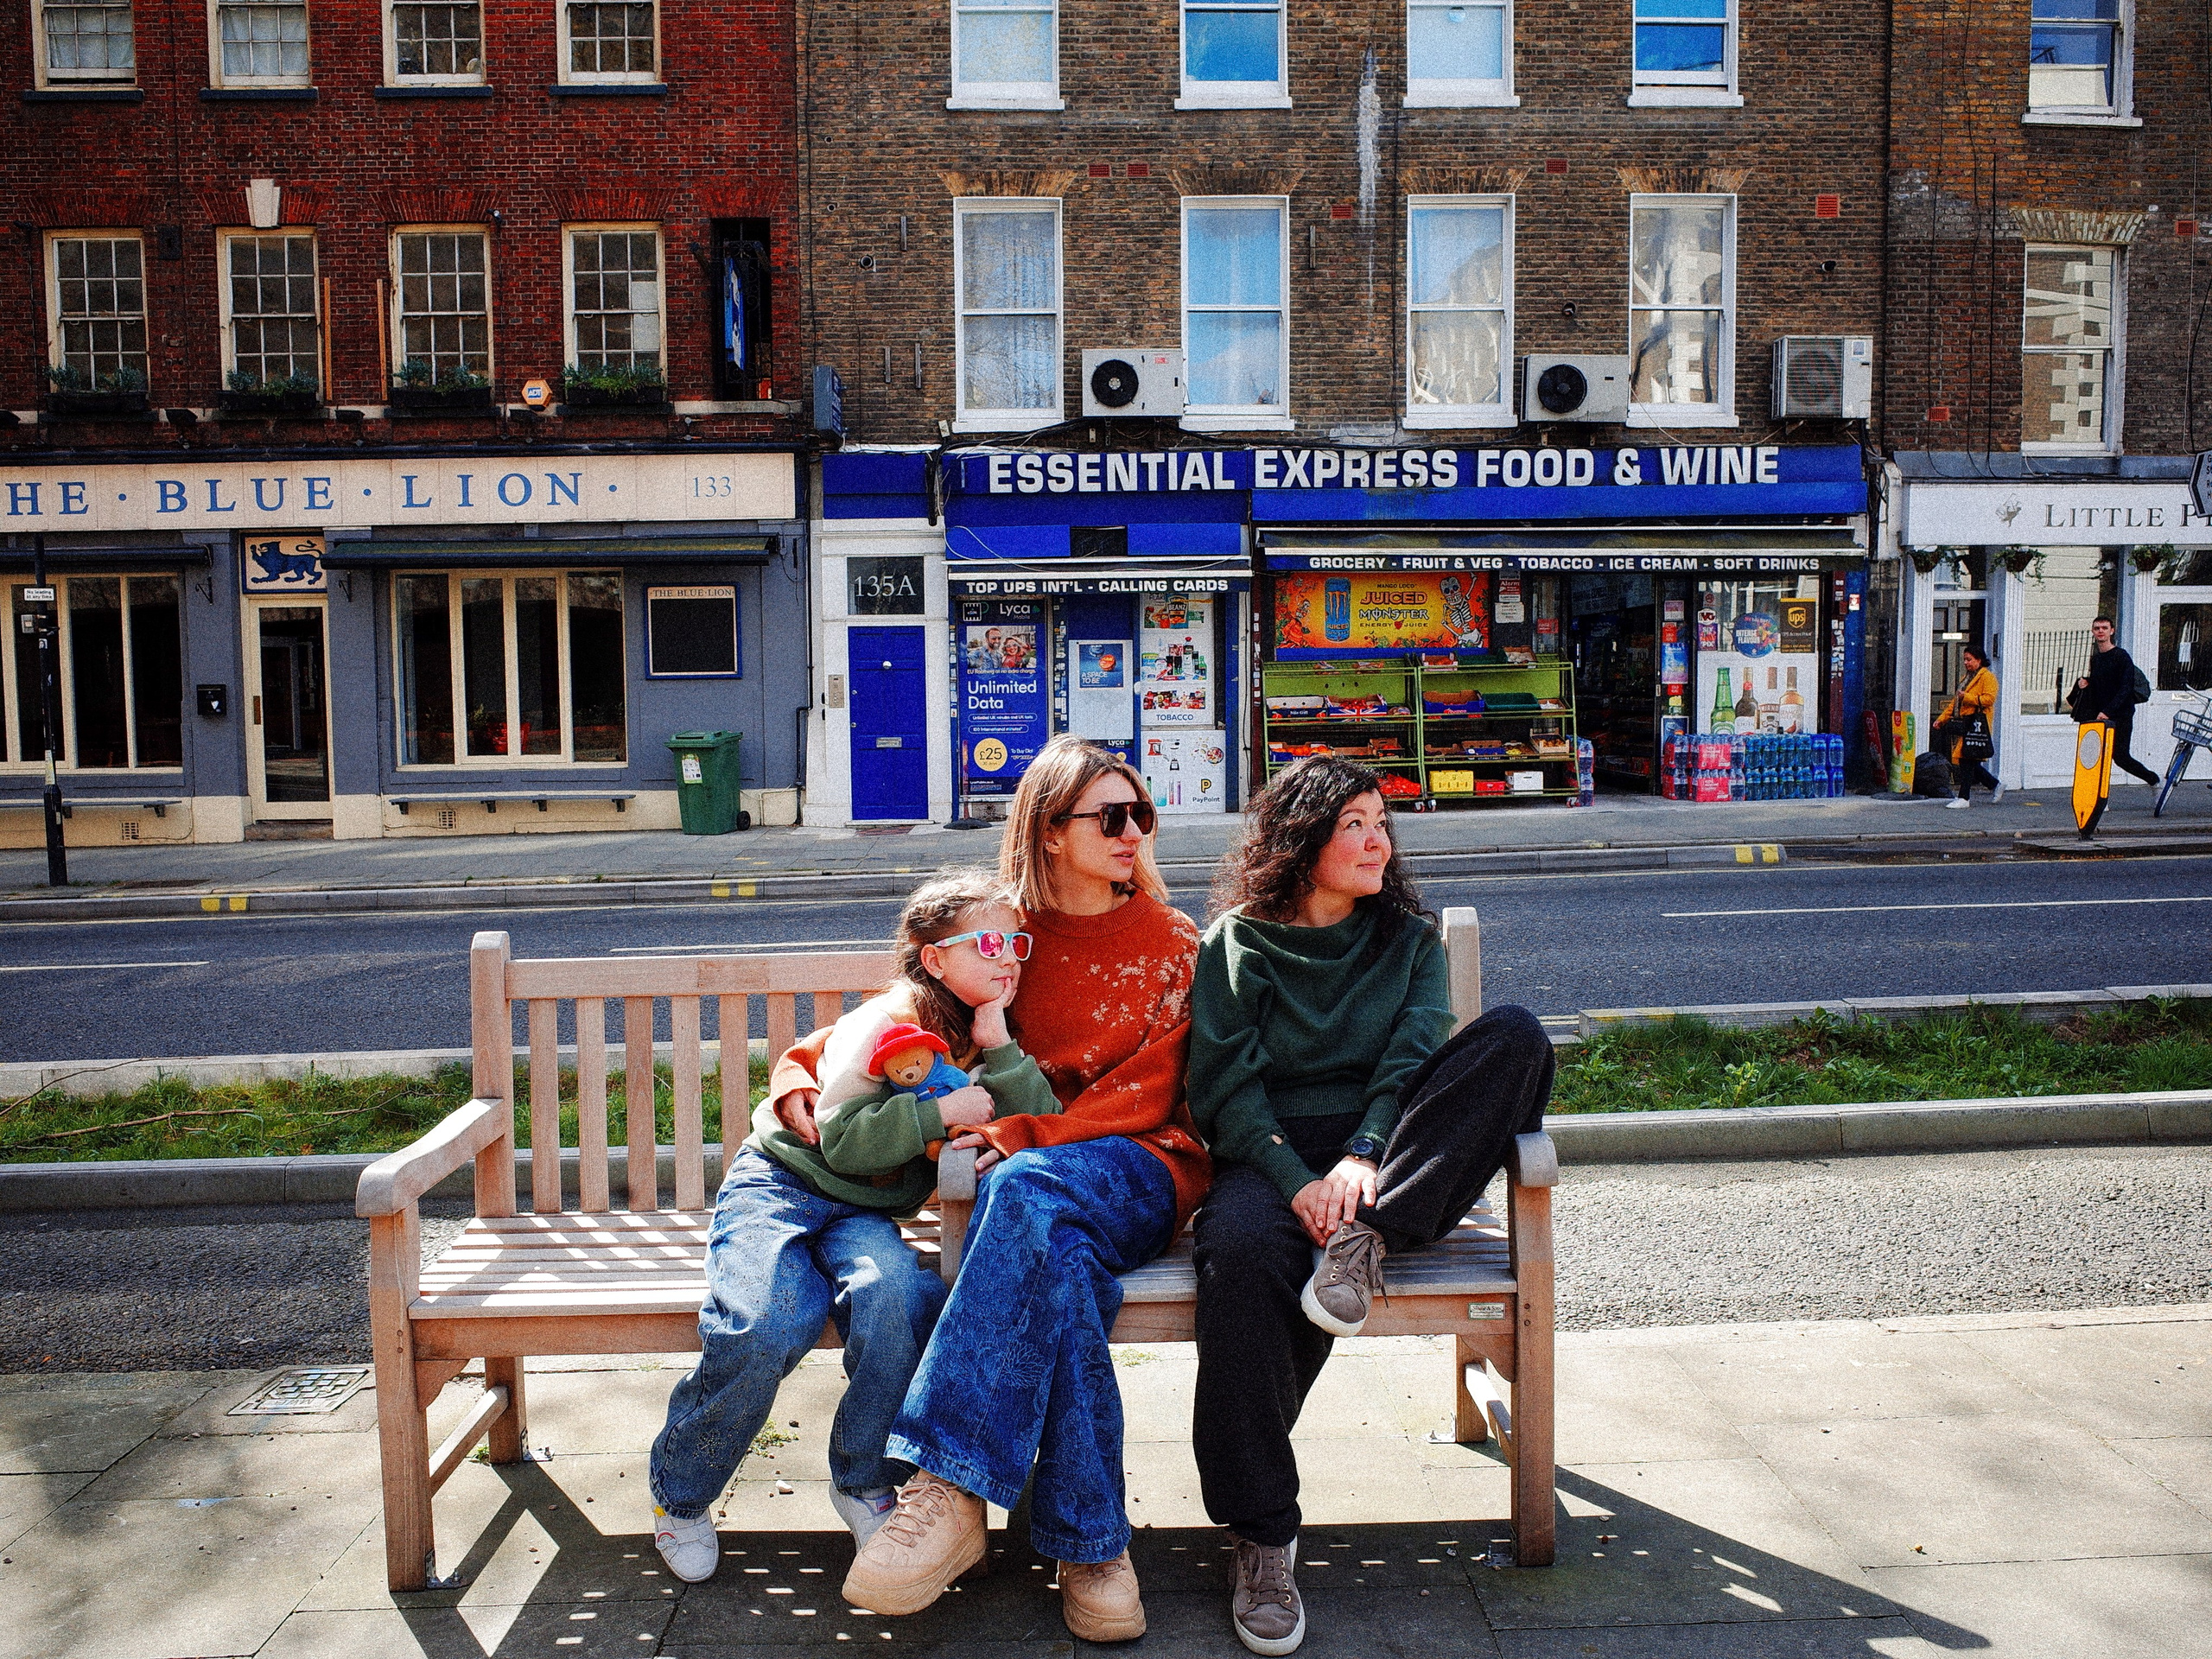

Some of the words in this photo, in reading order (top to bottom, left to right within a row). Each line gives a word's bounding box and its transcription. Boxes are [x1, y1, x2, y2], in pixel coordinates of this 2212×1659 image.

[988, 452, 1235, 493] ESSENTIAL
[1255, 449, 1458, 488] EXPRESS
[1477, 448, 1594, 487] FOOD
[1613, 448, 1643, 486] &
[1660, 446, 1779, 486] WINE
[155, 477, 335, 514] BLUE
[401, 473, 582, 509] LION
[692, 476, 732, 498] 133
[2042, 503, 2165, 528] LITTLE
[1309, 556, 1386, 570] GROCERY
[1402, 556, 1449, 570] FRUIT
[1453, 556, 1465, 569] &
[1470, 556, 1503, 569] VEG
[1518, 556, 1593, 570] TOBACCO
[1609, 557, 1634, 570] ICE
[1641, 557, 1698, 570] CREAM
[1713, 557, 1753, 570] SOFT
[1758, 557, 1820, 570] DRINKS
[854, 575, 918, 597] 135A
[966, 582, 997, 594] TOP
[1003, 581, 1036, 594] UPS
[1042, 581, 1083, 594] INT'L
[1098, 580, 1167, 594] CALLING
[1173, 579, 1229, 593] CARDS
[1360, 591, 1428, 606] JUICED
[1000, 603, 1031, 617] Lyca
[1359, 607, 1430, 621] MONSTER
[1789, 613, 1805, 626] ups
[968, 679, 1037, 694] Unlimited
[968, 696, 1004, 709] Data
[979, 747, 1002, 760] £25
